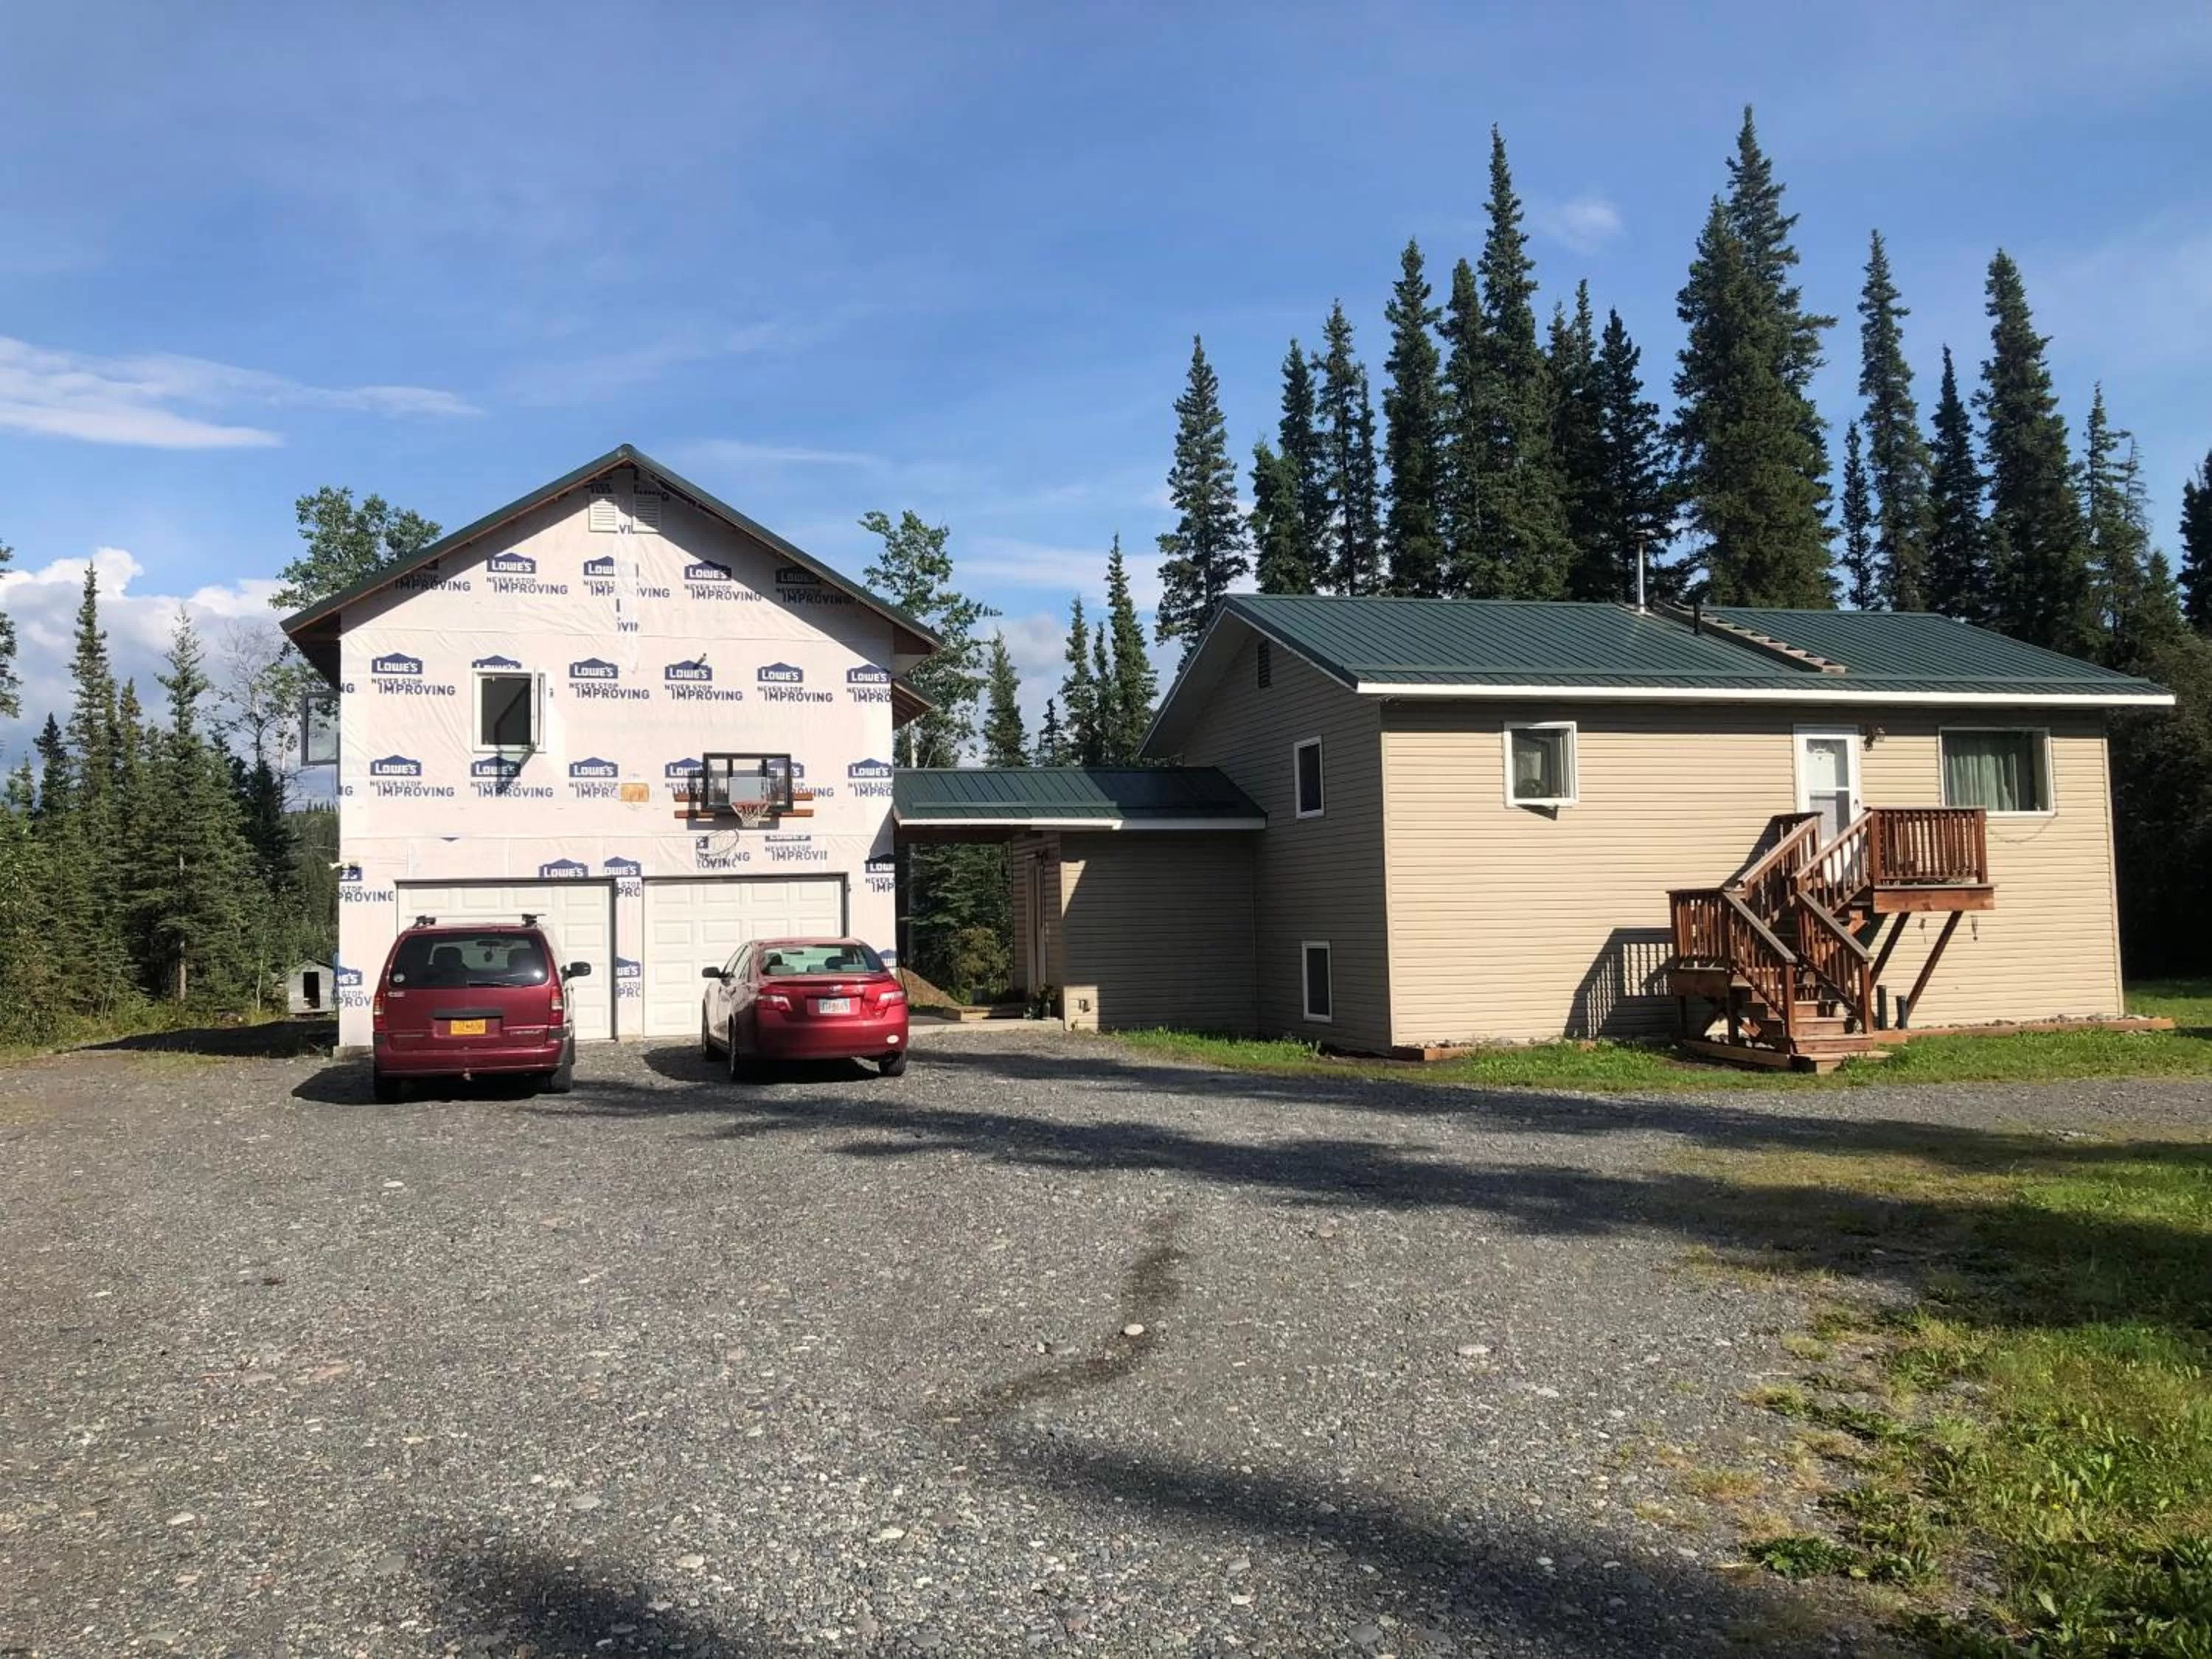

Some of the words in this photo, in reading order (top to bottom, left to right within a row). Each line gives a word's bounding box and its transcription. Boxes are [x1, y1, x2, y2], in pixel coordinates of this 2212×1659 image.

[492, 560, 532, 571] LOWE'S
[689, 568, 727, 579] LOWE'S
[493, 582, 568, 595] IMPROVING
[691, 589, 762, 602] IMPROVING
[377, 660, 418, 672] LOWE'S
[574, 665, 613, 677] LOWE'S
[669, 668, 708, 679] LOWE'S
[762, 669, 799, 681] LOWE'S
[852, 671, 887, 682] LOWE'S
[378, 684, 456, 695] IMPROVING
[576, 688, 650, 700] IMPROVING
[672, 689, 743, 701] IMPROVING
[764, 692, 833, 703] IMPROVING
[375, 763, 417, 775] LOWE'S
[574, 765, 613, 776] LOWE'S
[852, 766, 888, 776] LOWE'S
[378, 786, 455, 797] IMPROVING
[478, 787, 554, 798] IMPROVING
[544, 867, 583, 877] LOWE'S
